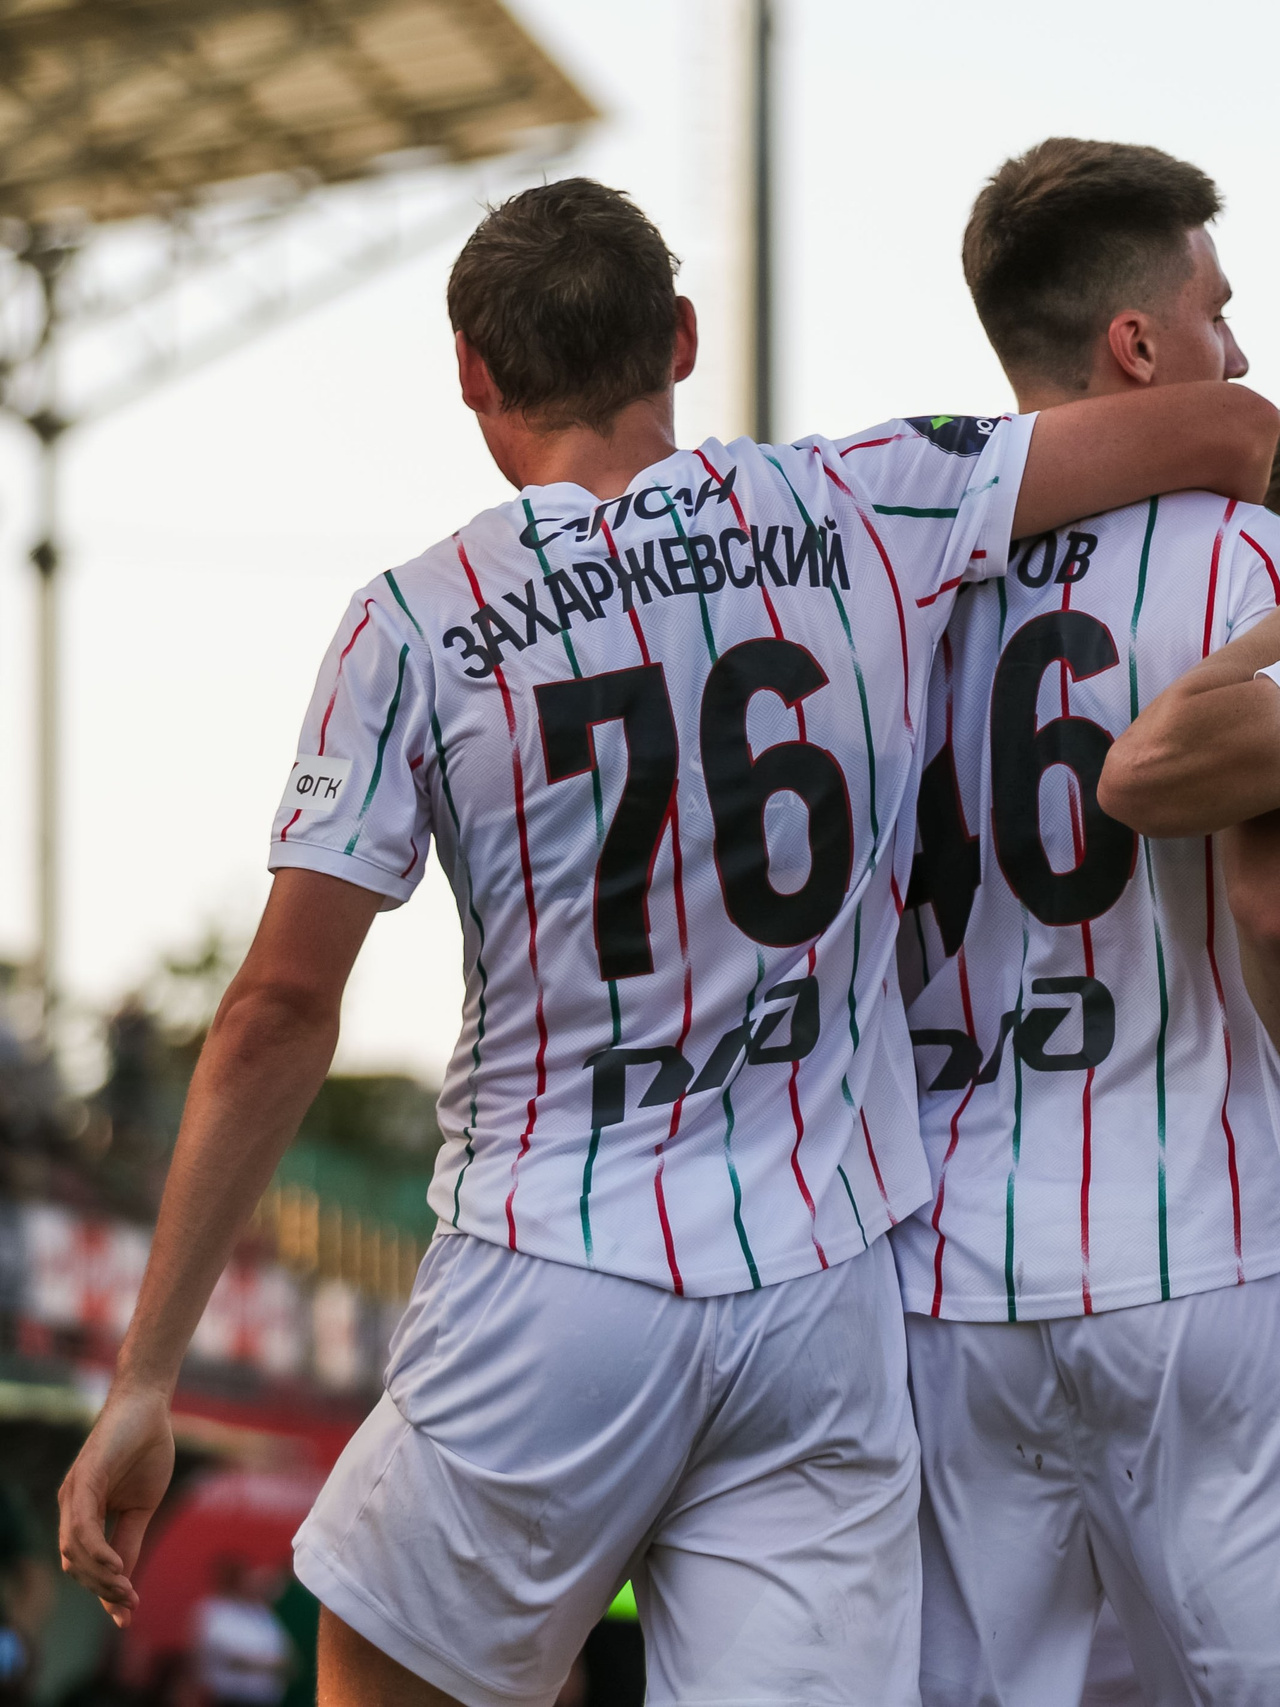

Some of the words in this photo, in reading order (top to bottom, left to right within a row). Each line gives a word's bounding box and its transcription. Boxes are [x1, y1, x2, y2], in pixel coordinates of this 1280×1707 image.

[443, 517, 850, 678] ЗАХАРЖЕВСКИЙ
[296, 773, 344, 800] ФГК
[533, 637, 854, 981] 76
